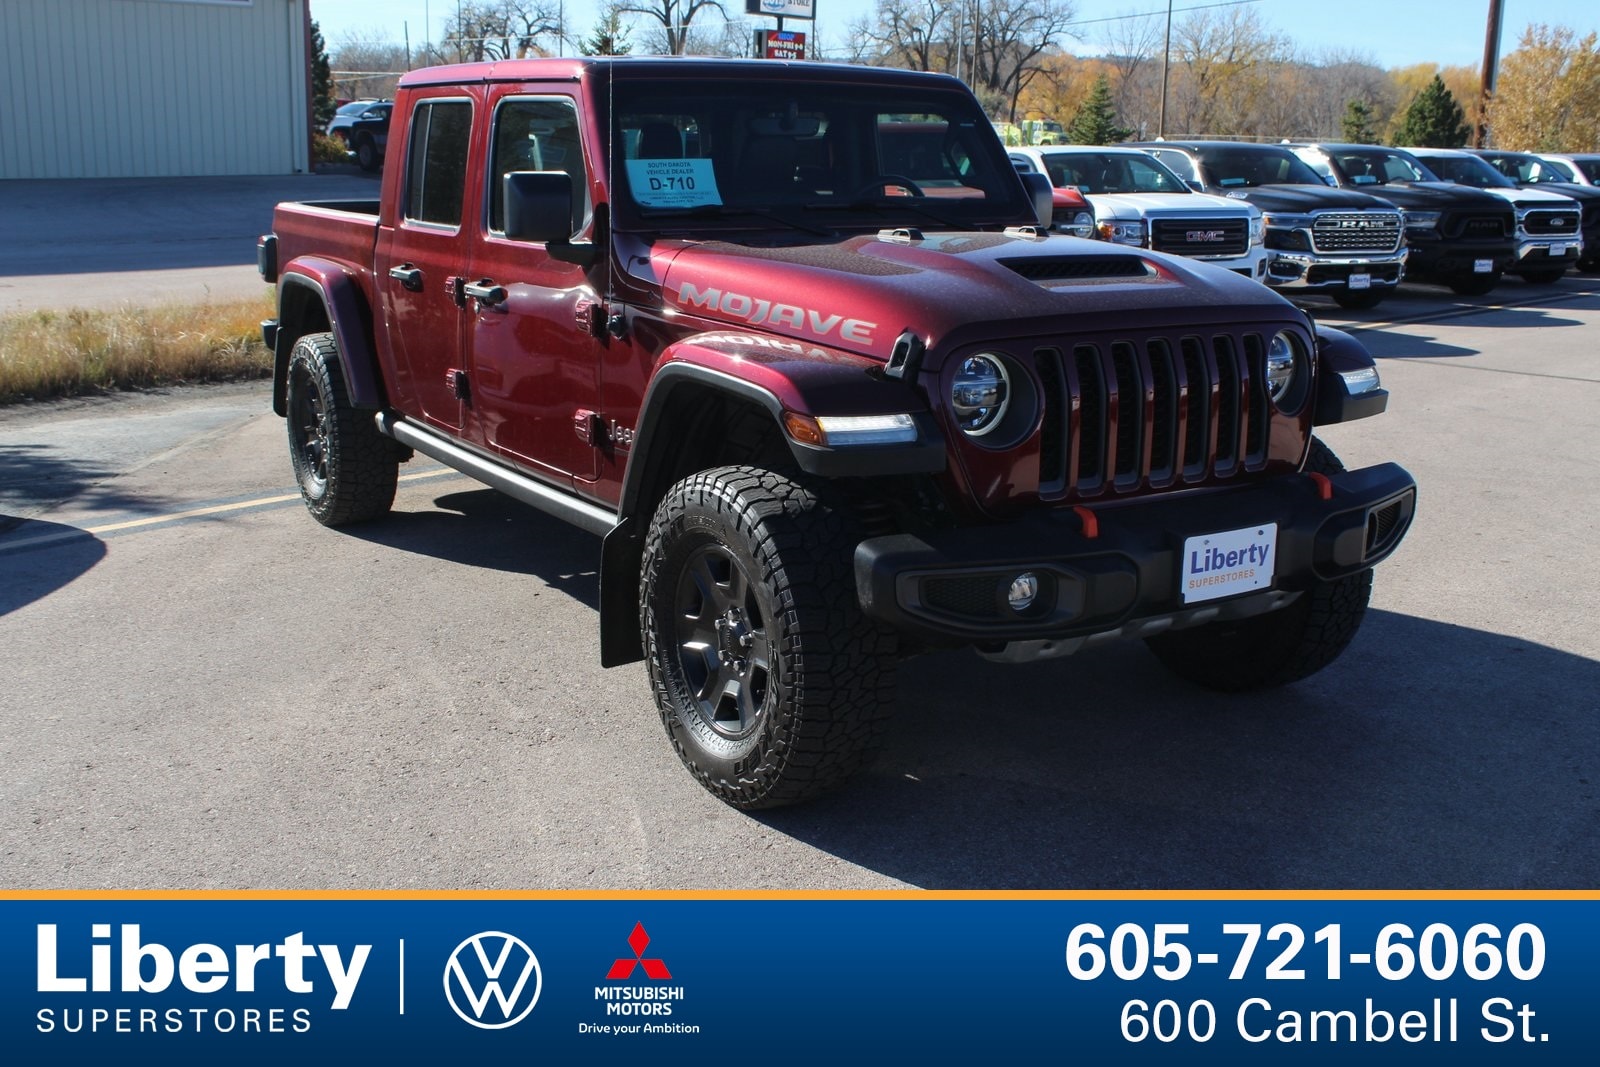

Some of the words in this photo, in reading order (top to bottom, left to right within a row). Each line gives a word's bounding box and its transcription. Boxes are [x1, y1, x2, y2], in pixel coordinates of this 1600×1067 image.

[649, 176, 695, 190] D-710
[1186, 230, 1225, 241] GMC
[677, 281, 878, 346] MOJAVE
[1191, 543, 1270, 574] Liberty
[1188, 568, 1255, 589] SUPERSTORES
